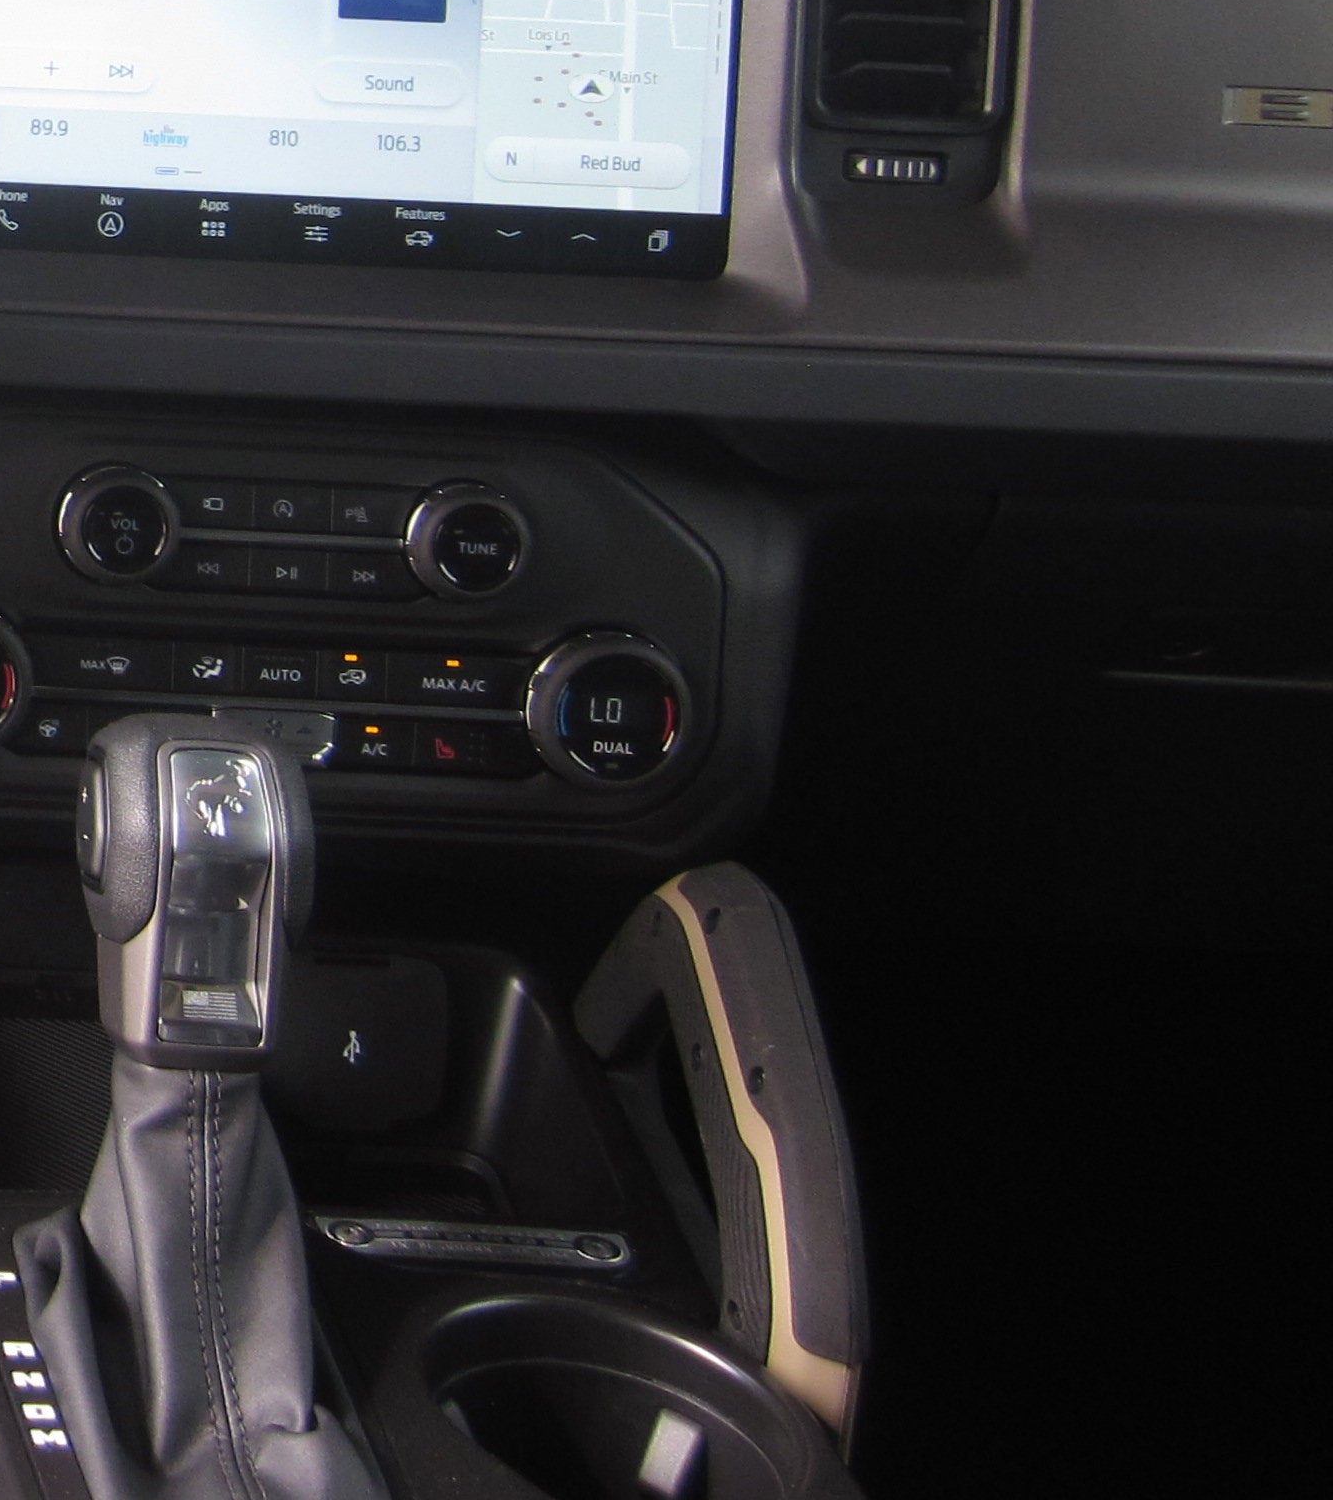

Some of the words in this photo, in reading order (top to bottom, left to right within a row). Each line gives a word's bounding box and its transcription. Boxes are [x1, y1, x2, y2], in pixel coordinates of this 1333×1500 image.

[528, 28, 554, 41] Lois
[364, 75, 414, 93] Sound
[609, 70, 640, 84] Main
[643, 71, 658, 85] St
[30, 119, 69, 137] 89.9
[143, 129, 190, 148] highway
[269, 130, 299, 148] 810
[376, 134, 422, 153] 106.3
[505, 151, 517, 166] N
[580, 155, 609, 171] Red
[613, 156, 642, 172] Bud
[100, 193, 125, 206] Nav
[200, 198, 230, 213] Apps
[293, 203, 342, 219] Settings
[395, 207, 446, 221] Features
[111, 518, 141, 532] VOL
[459, 541, 498, 556] TUNE
[80, 658, 106, 669] MAX
[260, 668, 301, 682] AUTO
[422, 677, 457, 692] MAX
[459, 678, 486, 693] A/C
[590, 698, 622, 724] LO
[360, 741, 388, 757] A/C
[593, 741, 633, 755] DUAL
[2, 1340, 35, 1358] R
[11, 1371, 45, 1387] N
[22, 1403, 56, 1421] D
[30, 1429, 68, 1446] M
